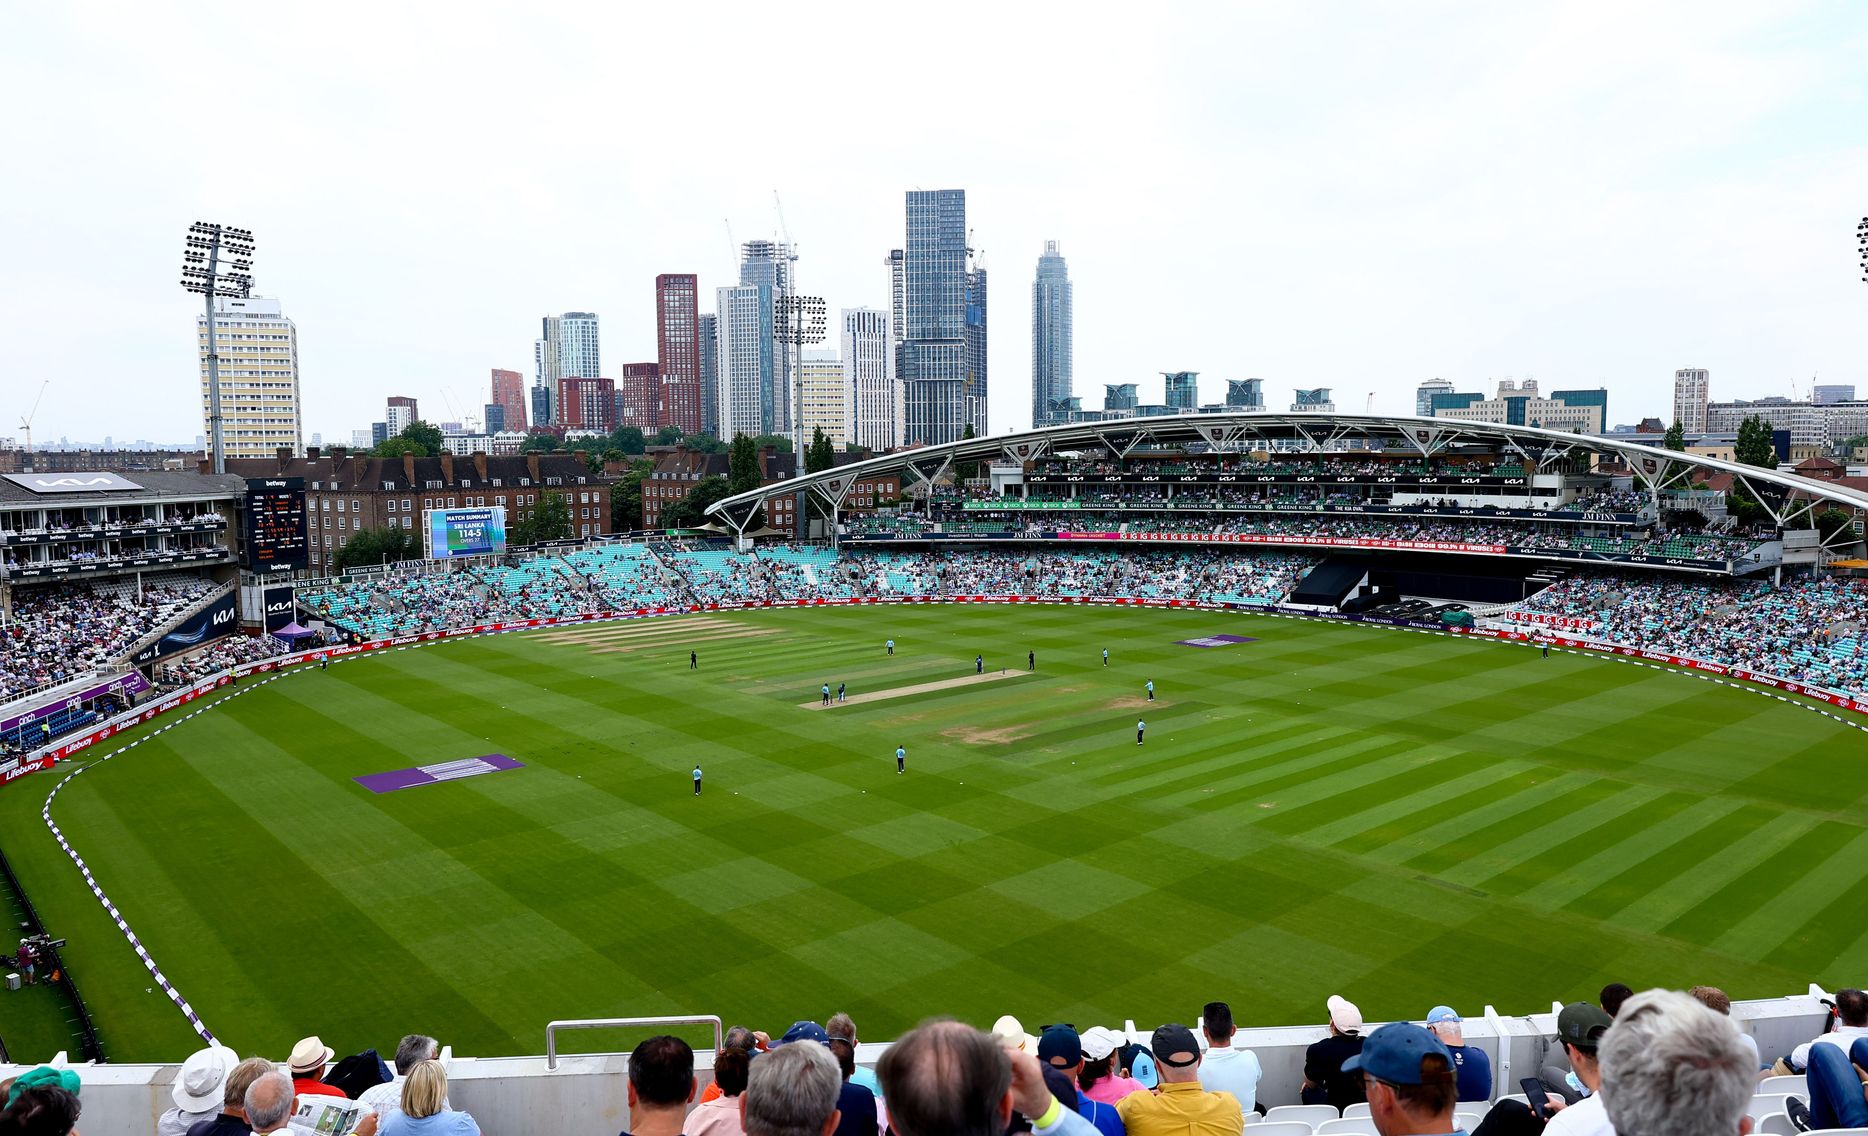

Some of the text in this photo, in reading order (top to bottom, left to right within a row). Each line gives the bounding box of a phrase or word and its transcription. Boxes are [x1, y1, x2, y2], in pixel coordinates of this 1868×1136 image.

[459, 529, 481, 538] 114-5
[268, 601, 291, 611] KIA
[213, 608, 234, 625] KIA
[501, 620, 529, 628] Lifebuoy
[446, 628, 474, 636] Lifebuoy
[1469, 628, 1499, 636] Lifebuoy
[390, 636, 419, 645] Lifebuoy
[332, 645, 363, 655] Lifebuoy
[1584, 642, 1614, 652] Lifebuoy
[1642, 652, 1670, 662] Lifebuoy
[1696, 662, 1723, 673] Lifebuoy
[109, 680, 122, 691] cinch
[1750, 674, 1778, 686] Lifebuoy
[1804, 688, 1831, 701] Lifebuoy
[67, 696, 81, 707] cinch
[159, 699, 180, 712] Lifebuoy
[19, 713, 35, 725] cinch
[116, 716, 140, 731] Lifebuoy
[65, 737, 93, 754] Lifebuoy
[6, 761, 43, 780] Lifebuoy
